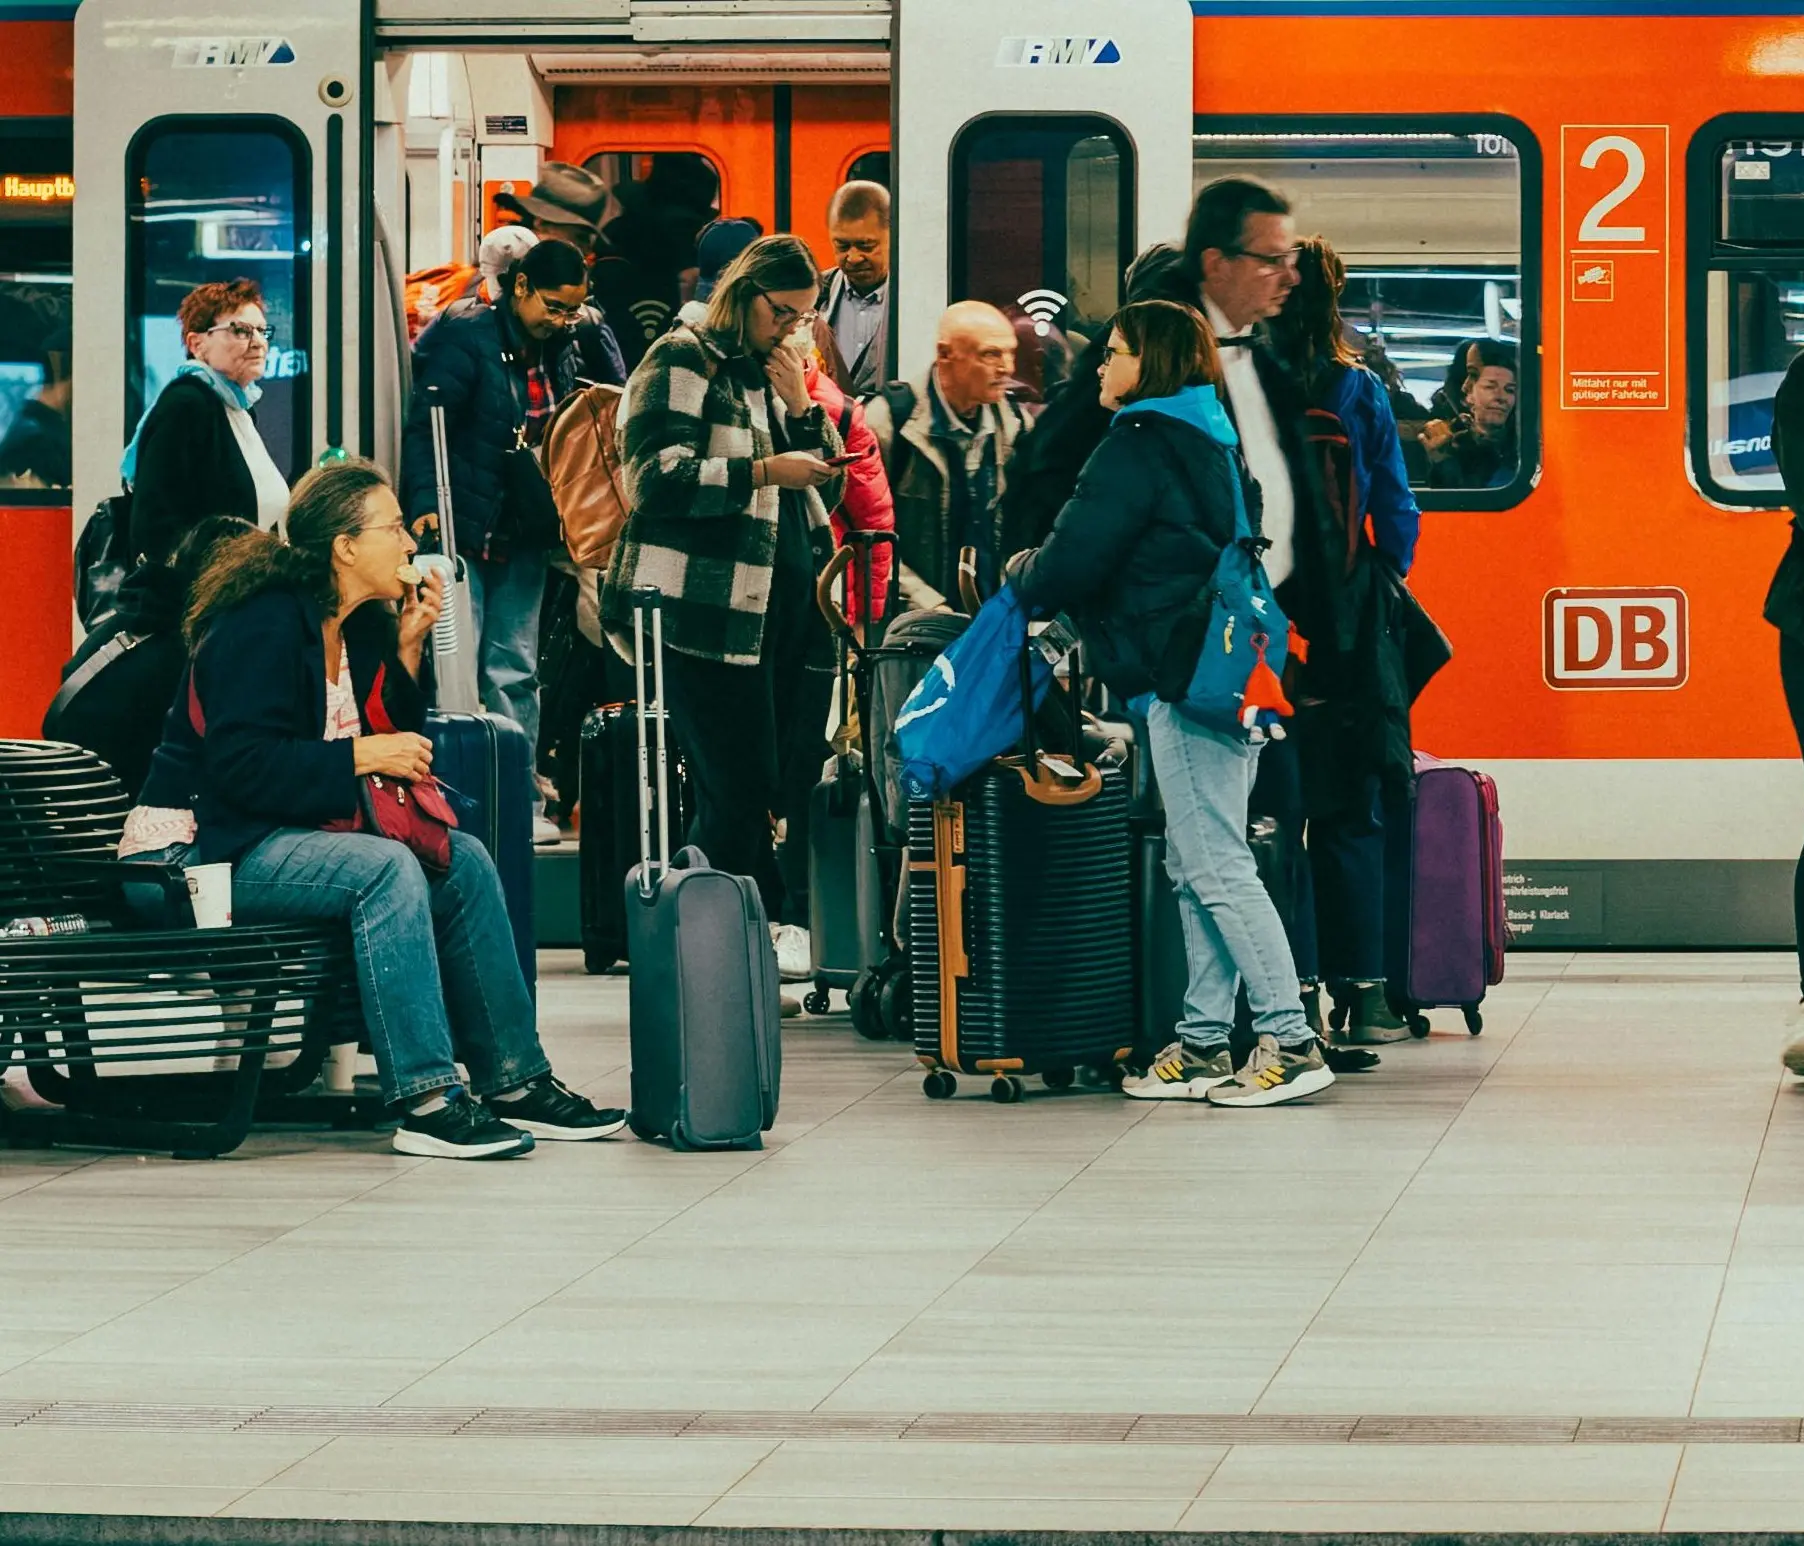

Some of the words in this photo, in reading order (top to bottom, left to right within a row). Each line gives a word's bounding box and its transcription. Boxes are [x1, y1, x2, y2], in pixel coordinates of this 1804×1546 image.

[1021, 37, 1109, 66] RMV
[1578, 135, 1646, 242] 2
[1572, 378, 1610, 388] Mitfahrt
[1612, 379, 1629, 388] nur
[1631, 378, 1647, 388] mit
[1572, 389, 1609, 401] gültiger
[1611, 389, 1659, 400] Fahrkarte
[1564, 606, 1669, 671] DB
